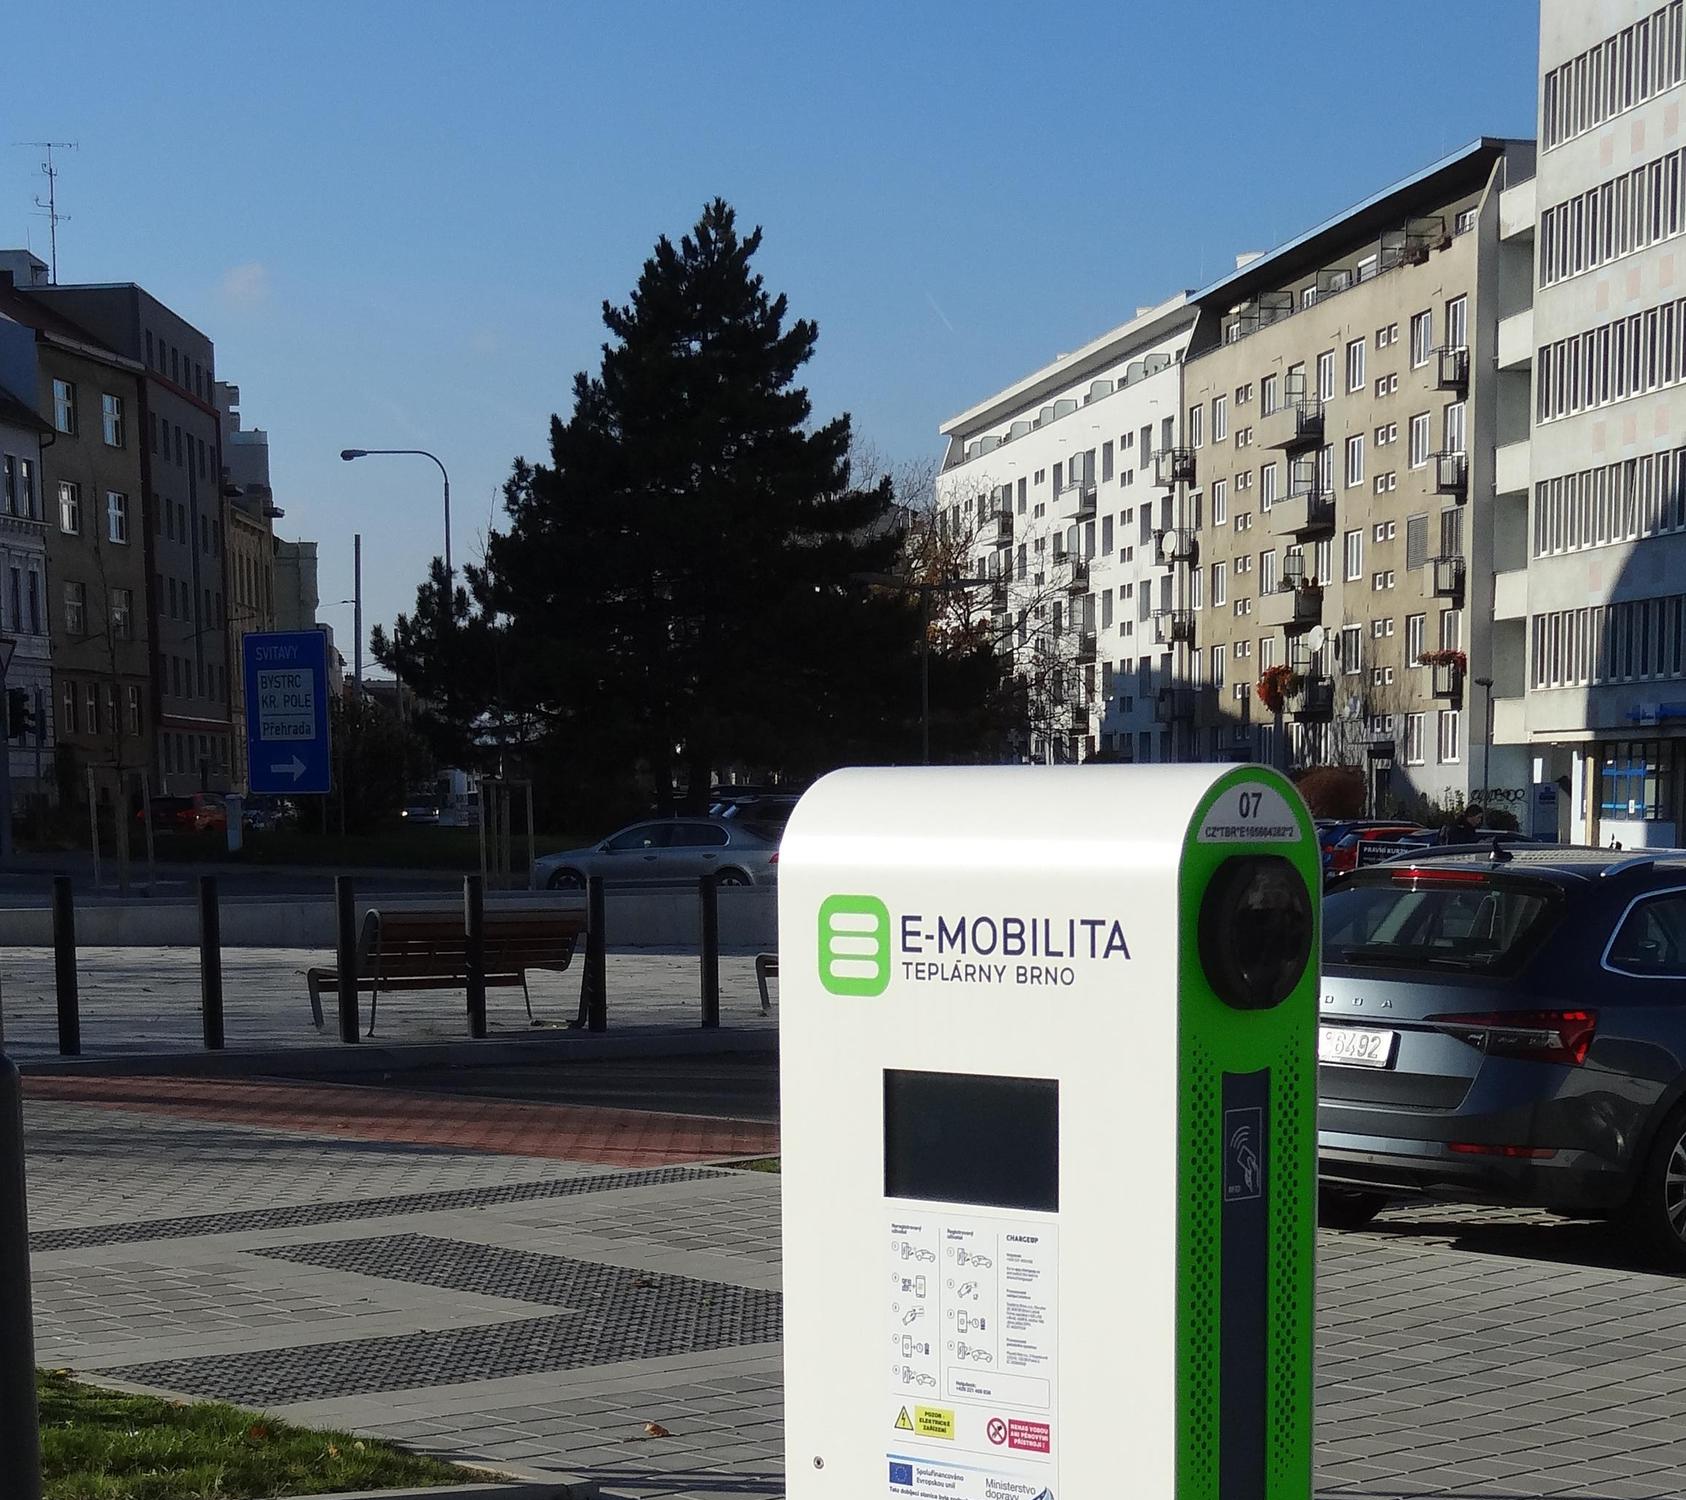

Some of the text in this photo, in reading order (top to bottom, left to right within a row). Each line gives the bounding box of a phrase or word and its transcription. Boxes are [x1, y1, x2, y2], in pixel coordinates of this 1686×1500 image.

[256, 646, 297, 661] SVITAVY
[261, 675, 302, 689] BYSTRC
[261, 694, 311, 708] KR. POLE
[263, 721, 311, 737] Přehrada
[1239, 792, 1262, 818] 07
[901, 915, 1131, 960] E-MOBILITA
[902, 960, 1075, 986] TEPLÁRNY BRNO
[1335, 1032, 1382, 1059] 6492
[919, 1417, 950, 1427] ELEKTRICKÉ
[924, 1411, 942, 1419] POZOR
[916, 1468, 964, 1482] Spolufinancováno
[916, 1477, 944, 1488] Evropskou
[985, 1478, 1036, 1495] Ministerstvo
